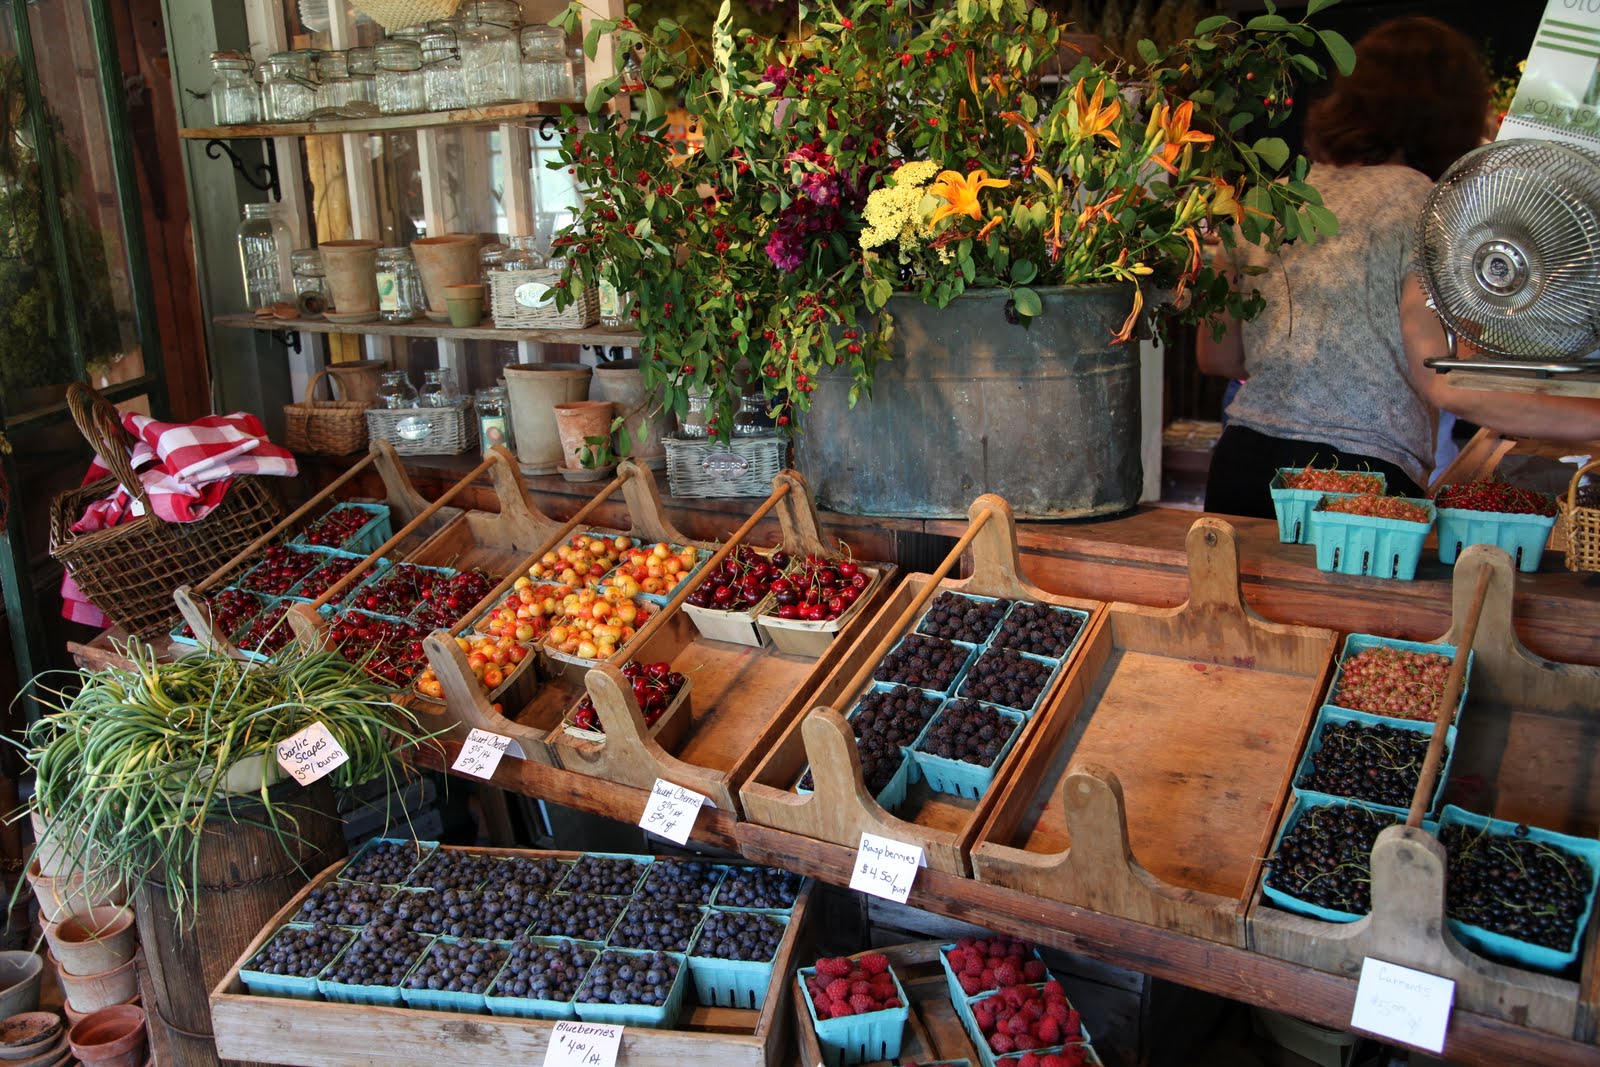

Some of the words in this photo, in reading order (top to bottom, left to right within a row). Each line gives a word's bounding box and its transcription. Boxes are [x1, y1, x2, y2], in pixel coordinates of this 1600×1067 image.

[279, 738, 308, 760] Garlic
[295, 738, 326, 764] Scapes
[674, 788, 701, 808] Cherries
[863, 840, 915, 865] Raspberries
[556, 1022, 615, 1038] Blueberries
